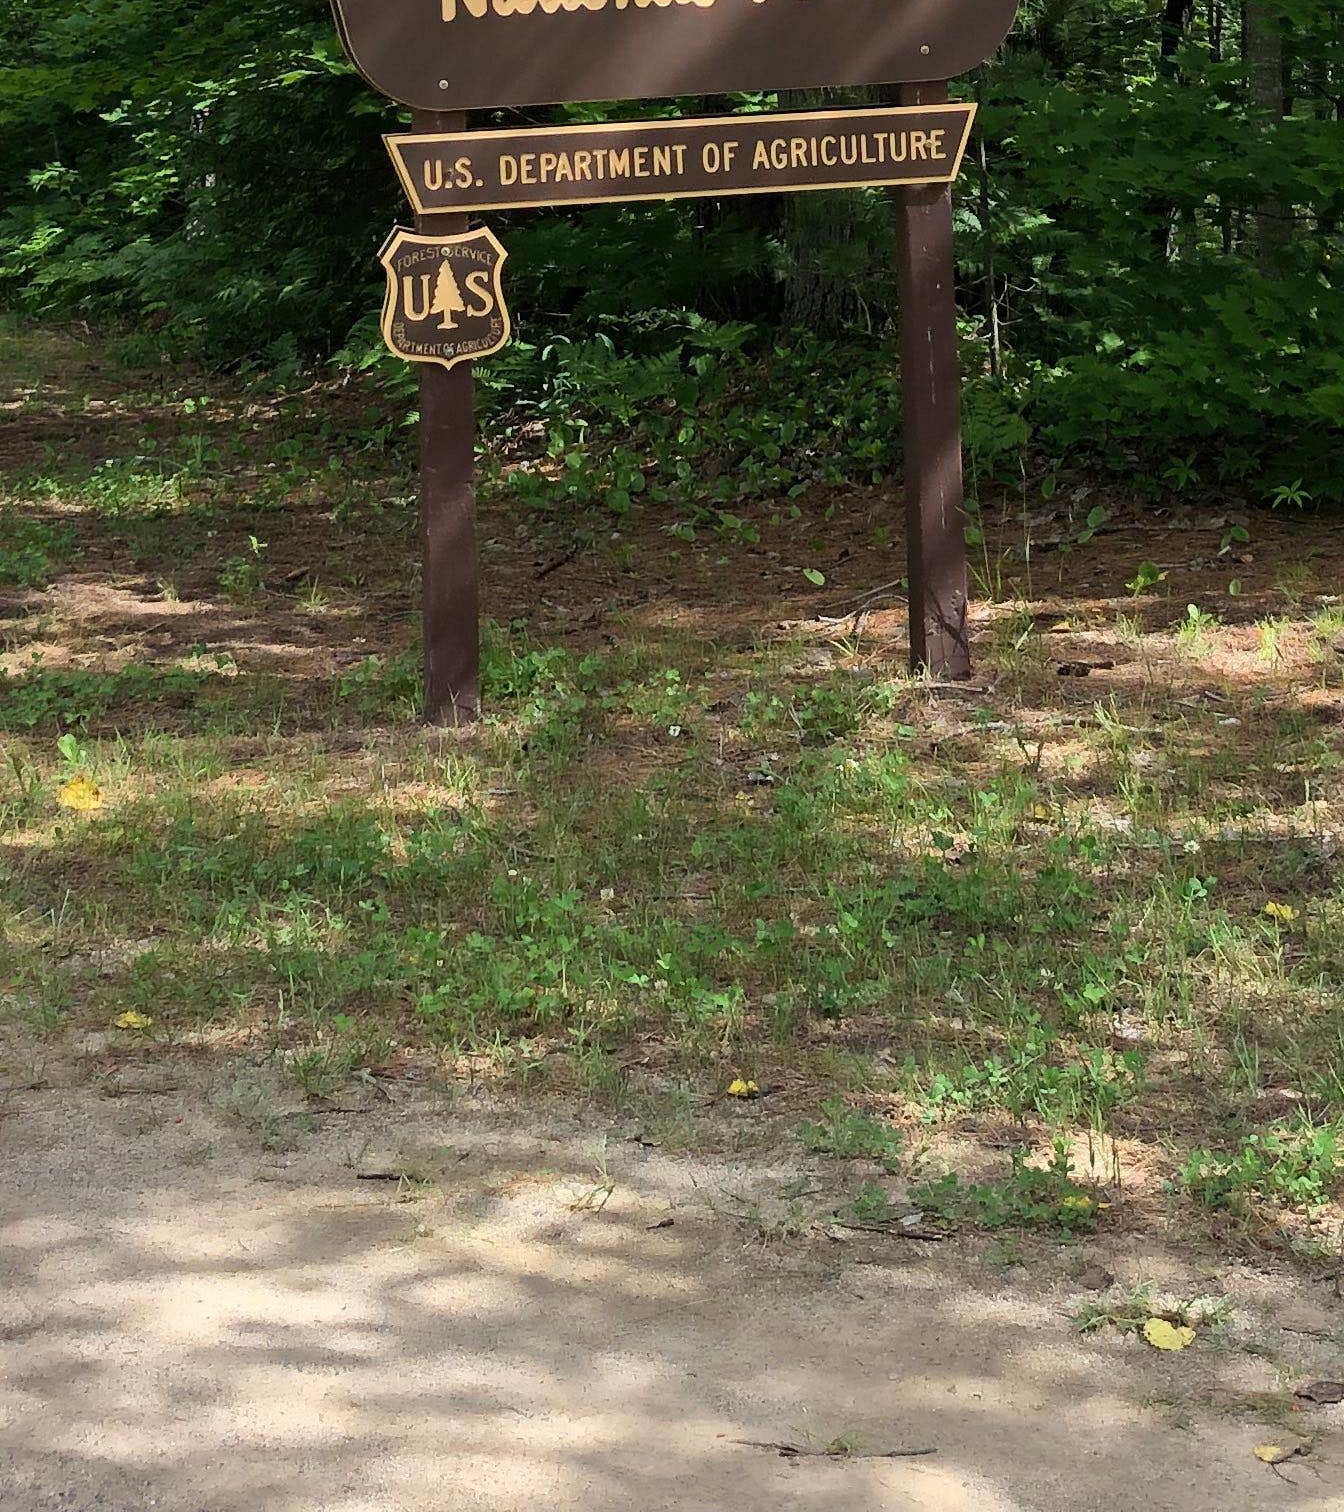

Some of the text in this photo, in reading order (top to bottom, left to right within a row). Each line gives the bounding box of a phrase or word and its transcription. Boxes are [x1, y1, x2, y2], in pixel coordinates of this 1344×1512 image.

[422, 128, 947, 192] U.S. DEPARTMENT OF AGRICULTURE
[397, 246, 493, 272] FOREST ERVICE
